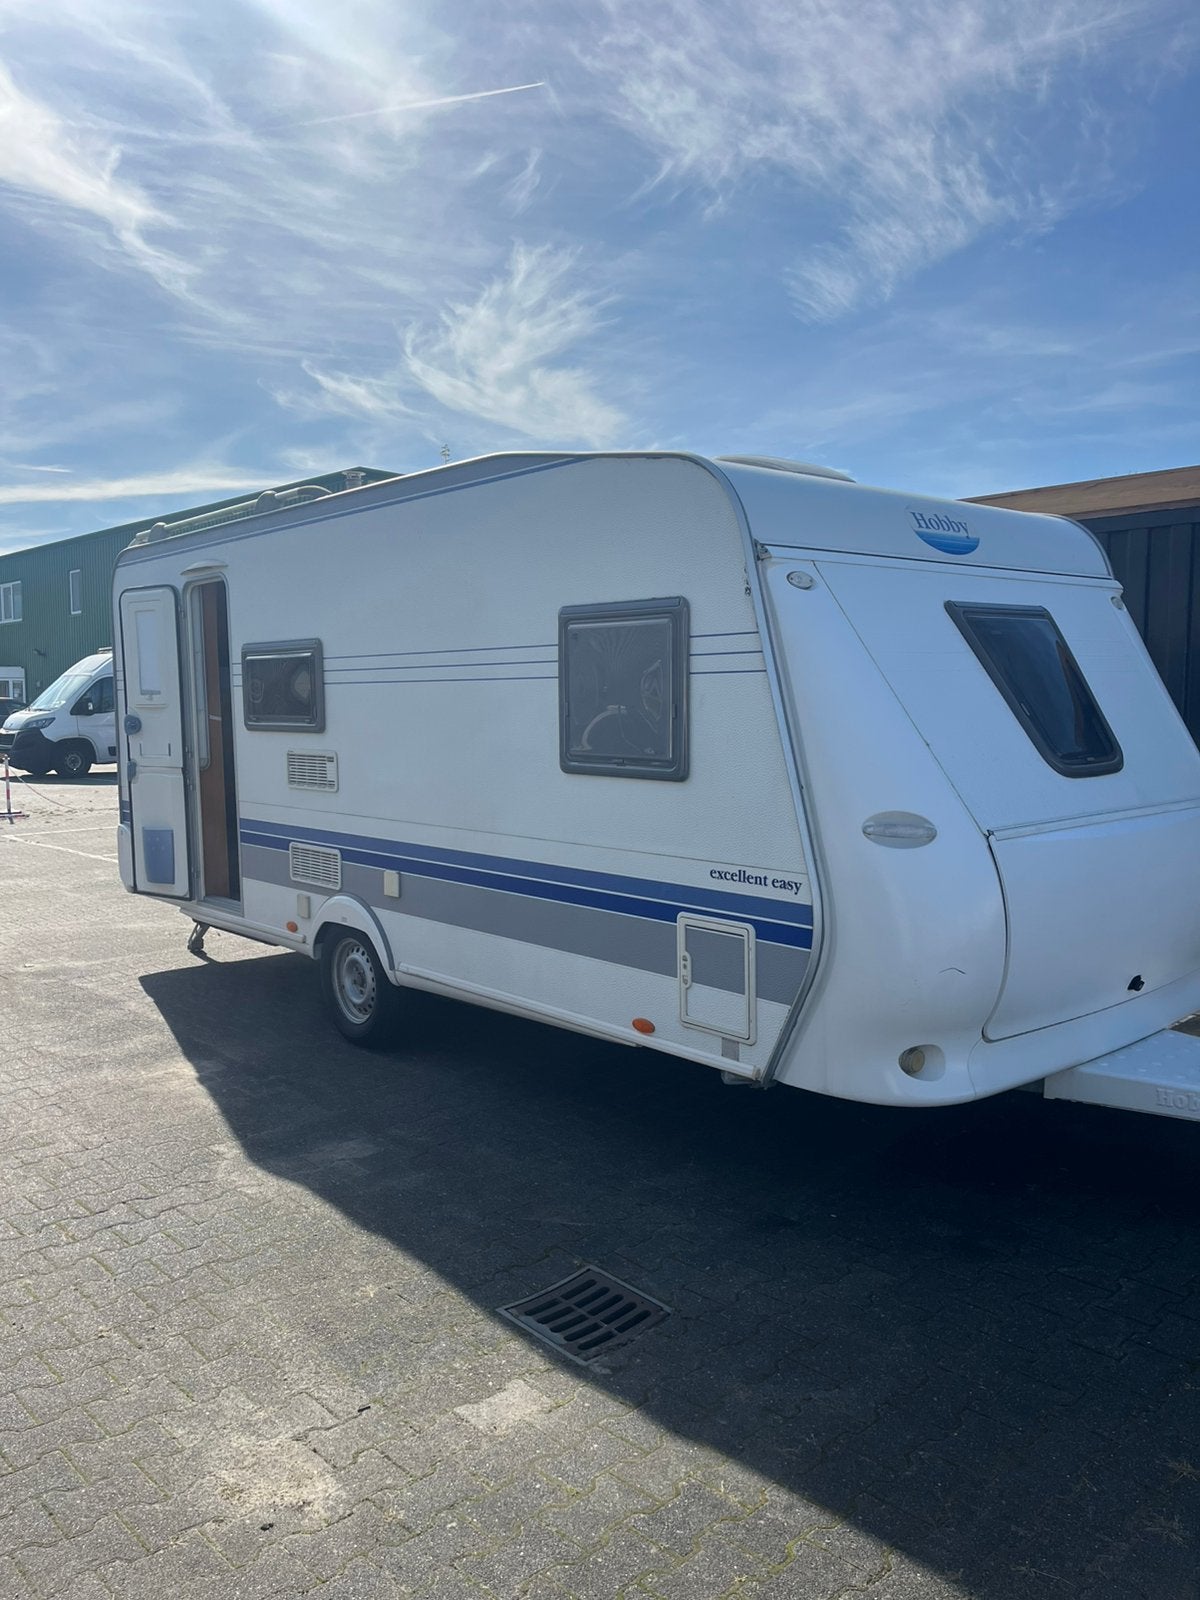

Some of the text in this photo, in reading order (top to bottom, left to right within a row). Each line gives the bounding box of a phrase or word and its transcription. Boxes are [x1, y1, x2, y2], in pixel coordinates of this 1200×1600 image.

[910, 511, 969, 540] Hobby
[709, 868, 802, 895] excellent easy
